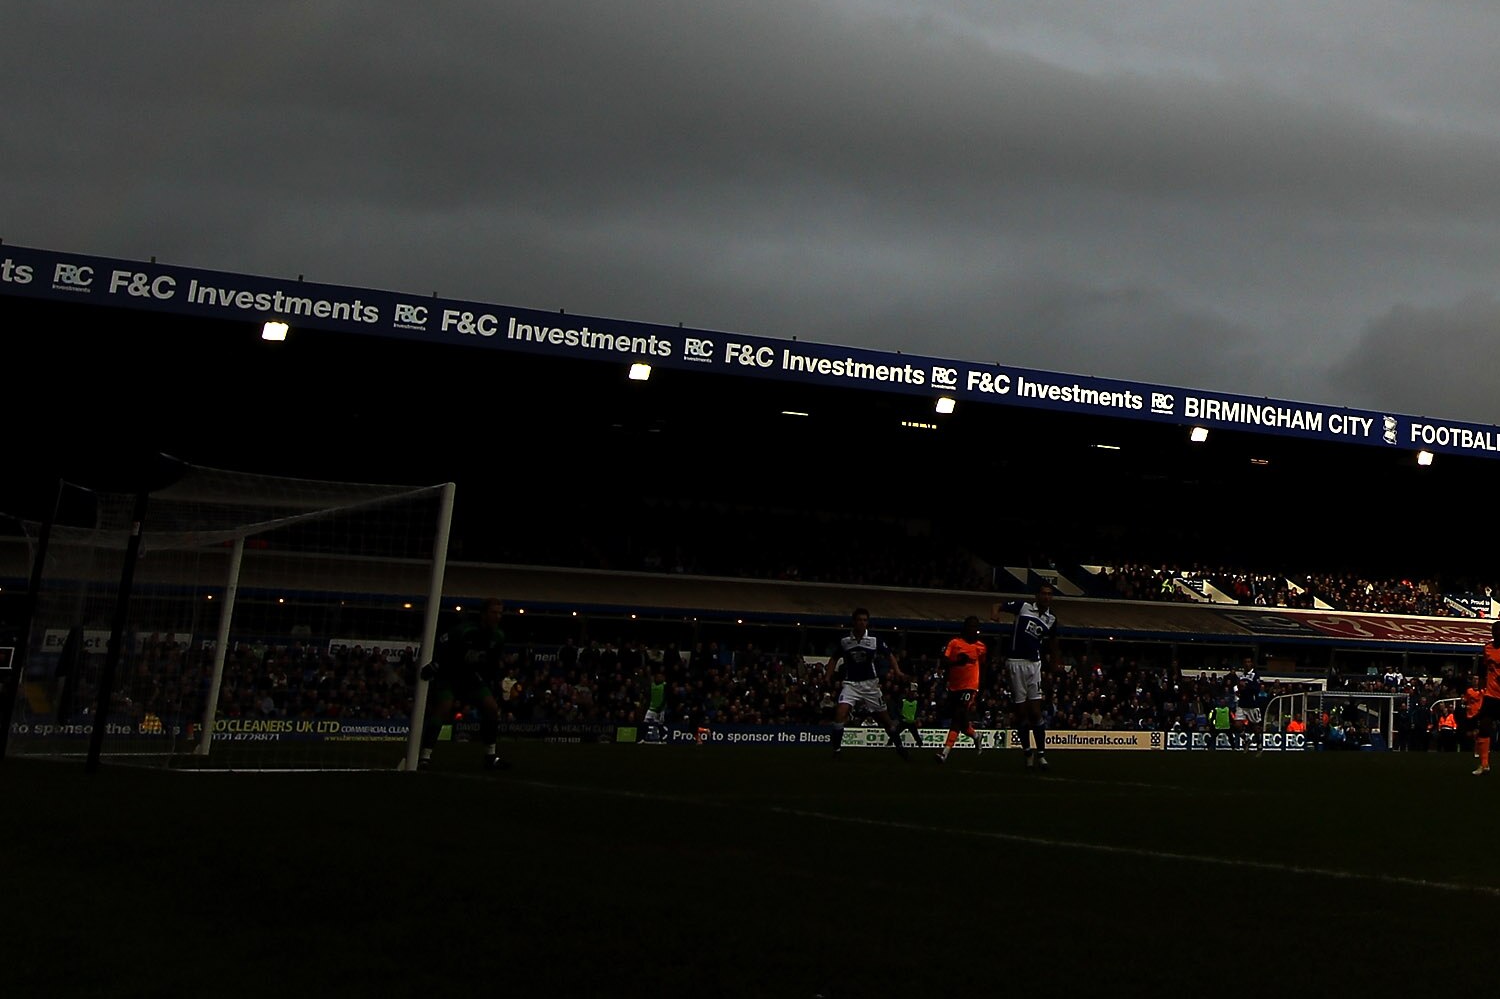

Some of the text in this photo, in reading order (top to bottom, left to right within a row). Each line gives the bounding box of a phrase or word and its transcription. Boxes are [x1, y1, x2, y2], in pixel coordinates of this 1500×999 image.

[109, 269, 379, 324] F&C Investments
[441, 309, 672, 357] F&C Investments
[724, 342, 925, 385] F&C Investments
[966, 370, 1143, 410] F&C Investments
[1184, 396, 1374, 437] BIRMINGHAM CITY
[296, 720, 314, 733] UK
[317, 720, 340, 733] LTD
[713, 732, 724, 742] to
[727, 731, 773, 744] sponsor
[777, 731, 796, 742] the
[799, 732, 832, 743] Blues
[1045, 735, 1138, 746] otballfunerals.co.uk
